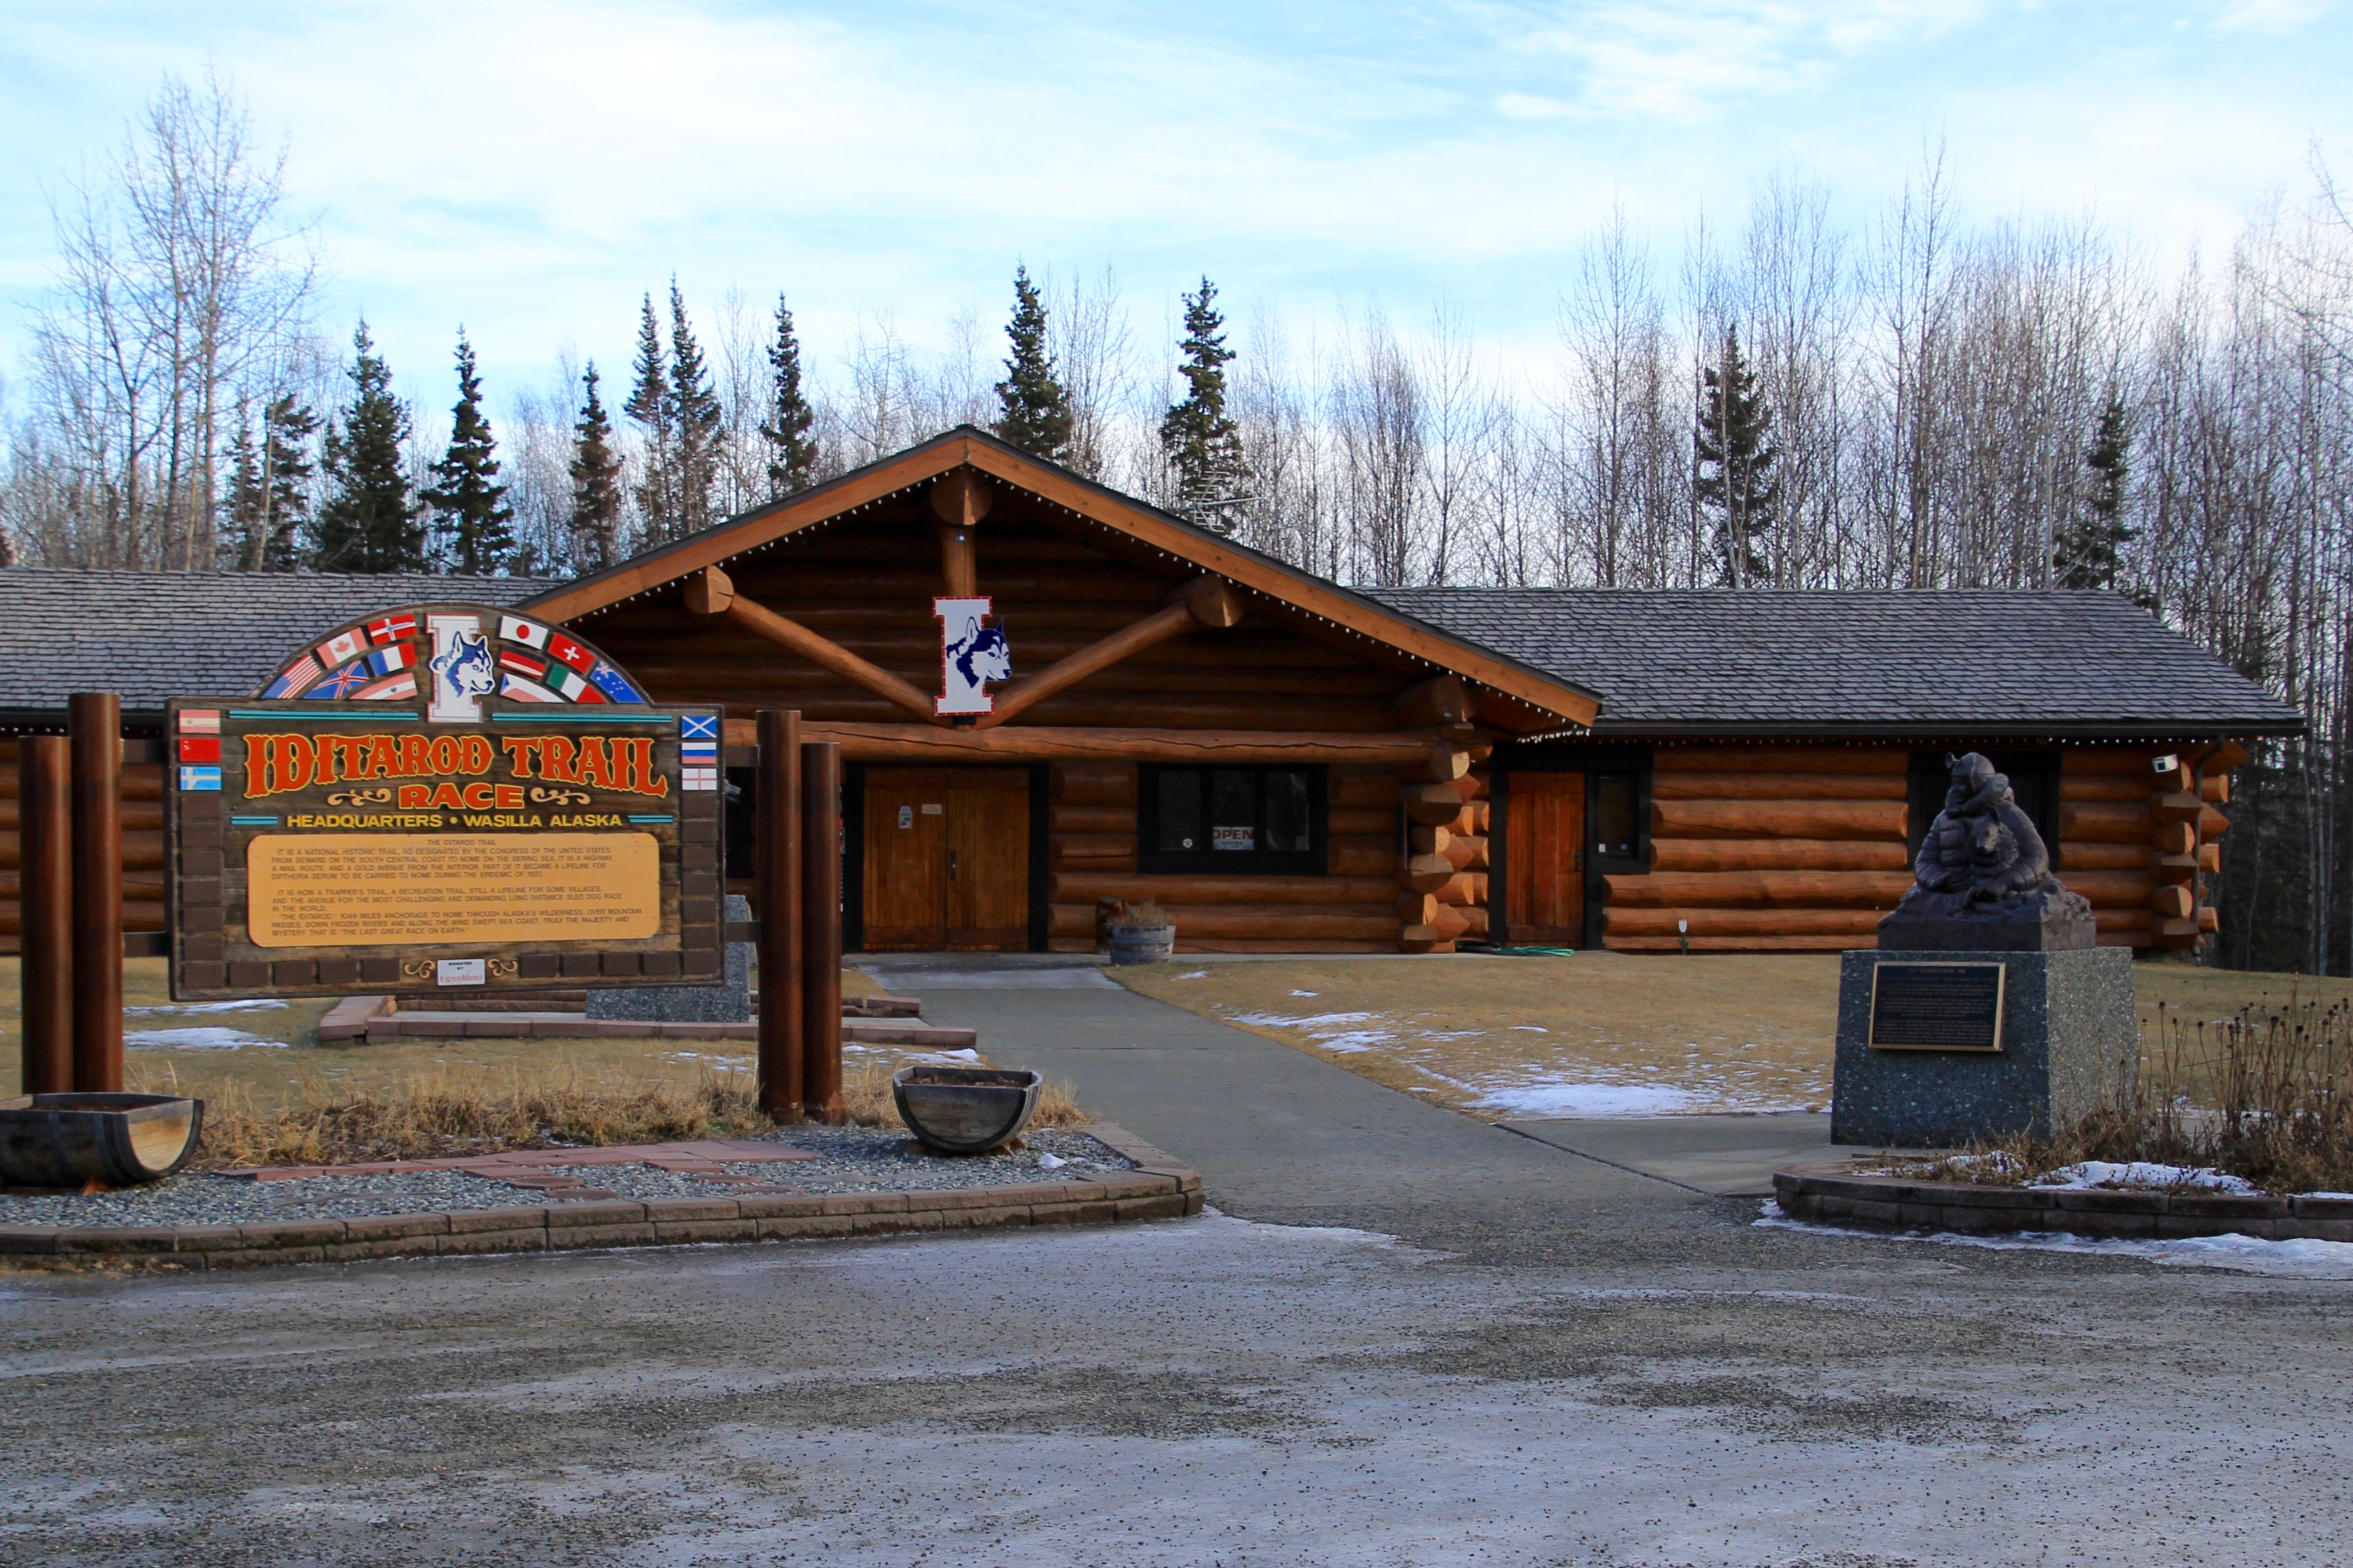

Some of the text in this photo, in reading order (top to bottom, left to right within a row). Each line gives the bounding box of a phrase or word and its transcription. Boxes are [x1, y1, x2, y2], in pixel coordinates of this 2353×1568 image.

[243, 733, 669, 799] IDITAROD TRAIL
[398, 783, 525, 809] RACE
[287, 814, 622, 828] HEADQUARTERS WASILLA ALASKA
[1213, 830, 1254, 839] OPEN
